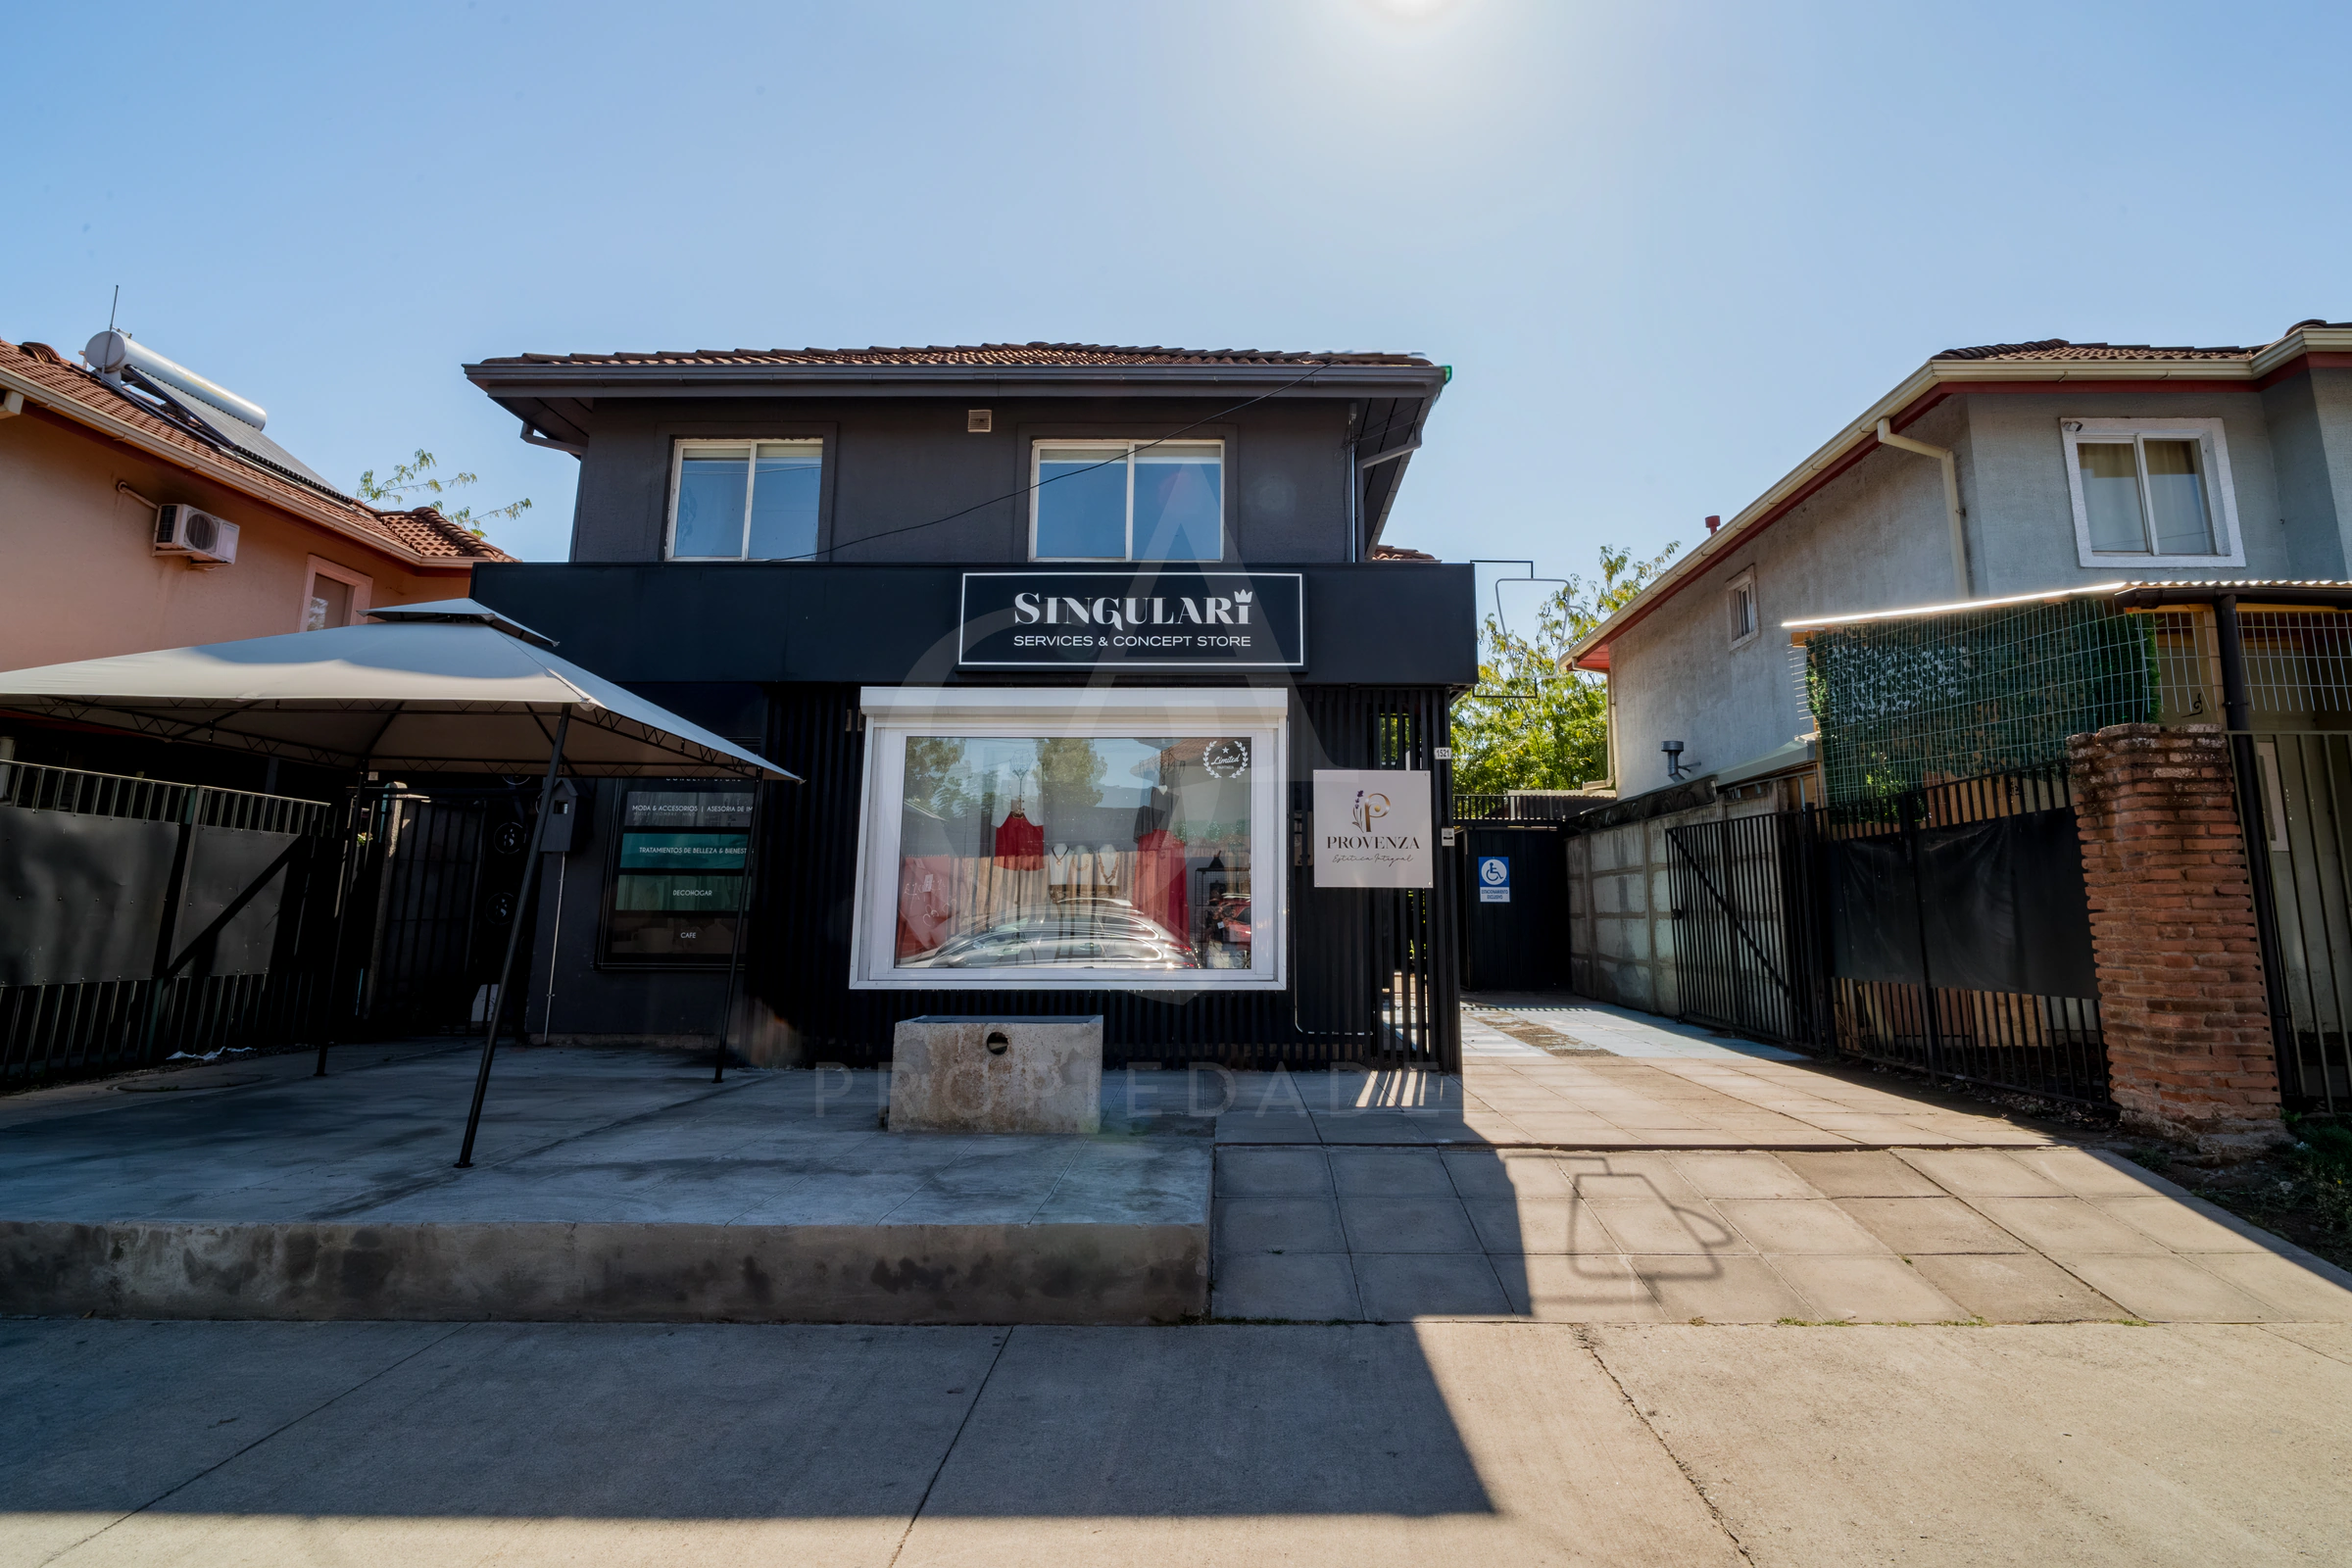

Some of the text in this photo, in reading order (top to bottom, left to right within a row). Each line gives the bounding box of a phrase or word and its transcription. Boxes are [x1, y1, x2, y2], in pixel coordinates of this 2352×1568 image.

[1013, 635, 1251, 647] SERVICES & CONCEPT STORE
[1210, 754, 1241, 765] Limited
[1436, 749, 1450, 758] 1521
[1327, 836, 1420, 850] PROVENZA
[1374, 853, 1414, 867] Integral
